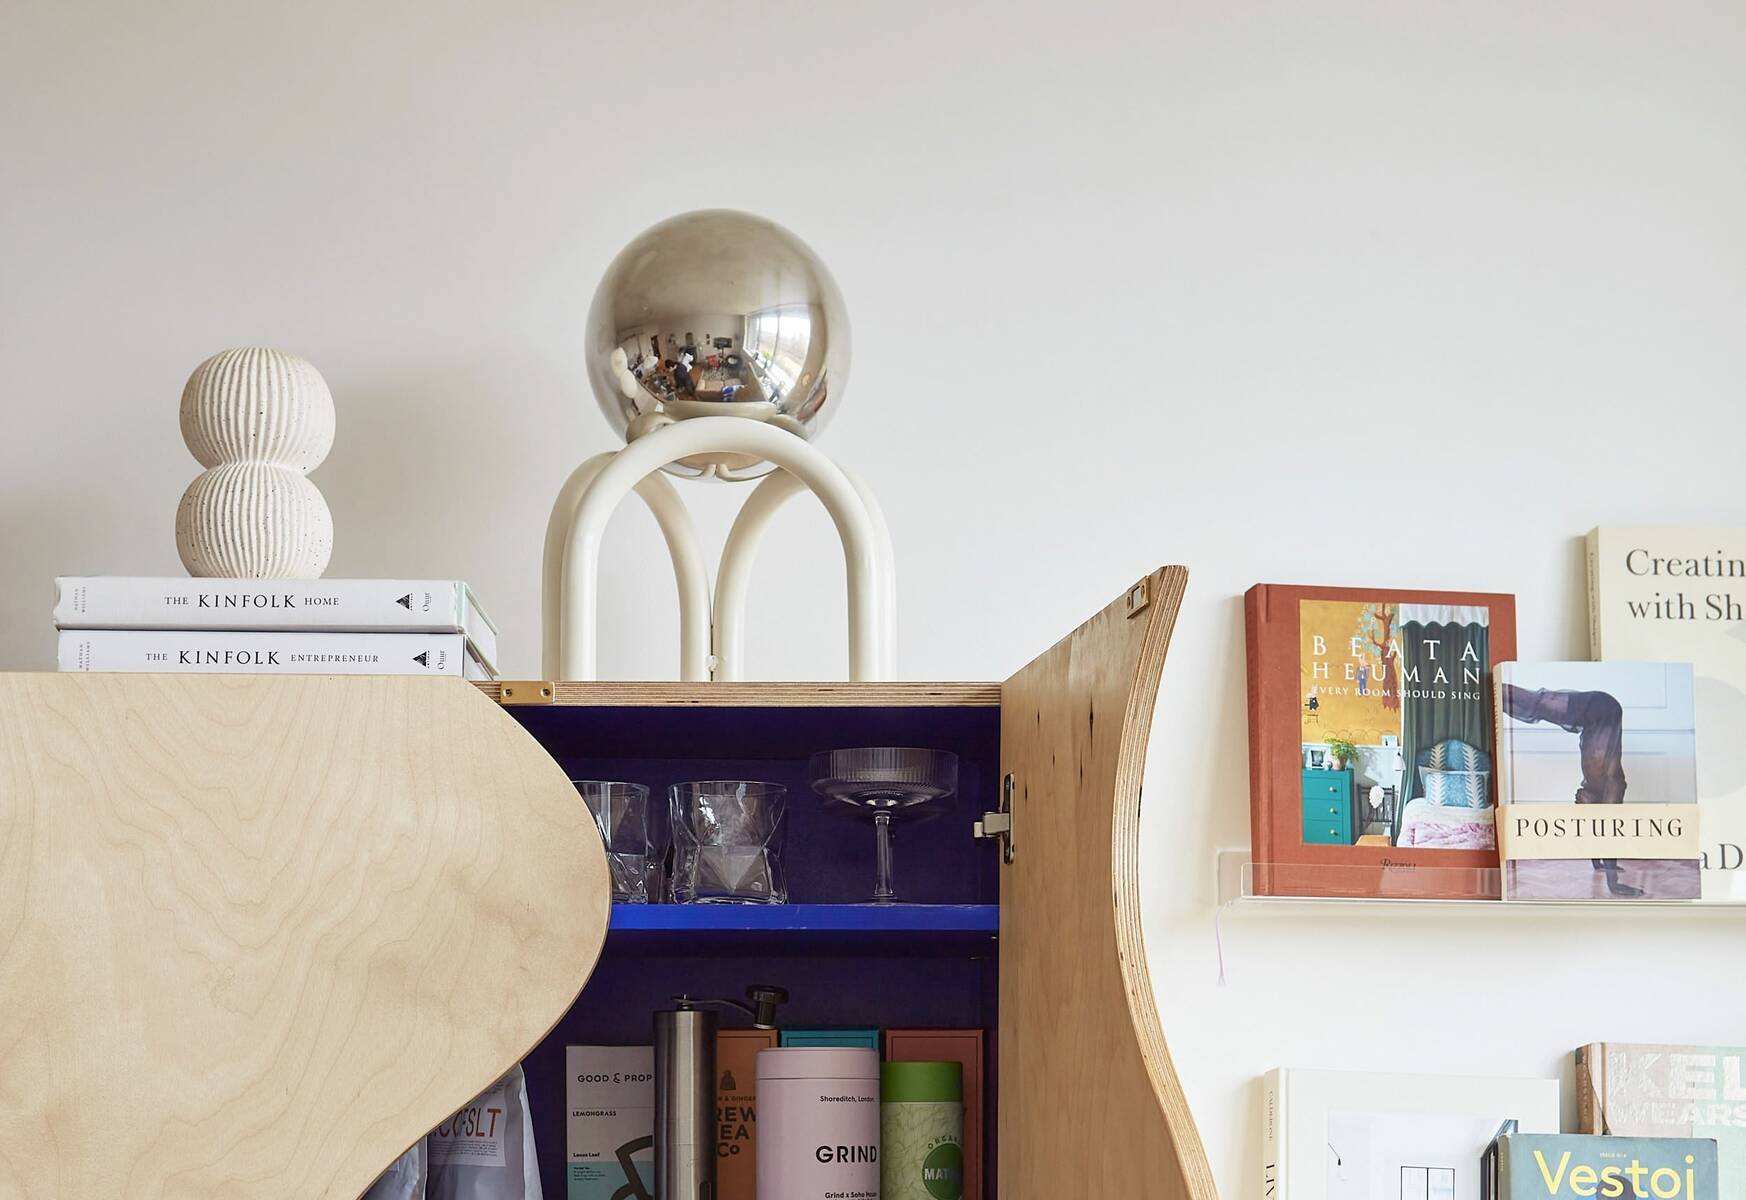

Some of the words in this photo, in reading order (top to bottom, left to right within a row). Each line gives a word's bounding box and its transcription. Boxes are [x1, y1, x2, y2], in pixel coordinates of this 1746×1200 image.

[164, 596, 189, 606] THE
[198, 594, 296, 609] KINFOLK
[304, 597, 340, 606] HOME
[1627, 592, 1696, 620] with
[1705, 593, 1743, 621] Sh
[1313, 635, 1480, 662] BEATA
[145, 652, 169, 661] THE
[179, 650, 281, 666] KINFOLK
[290, 653, 379, 663] ENTREPRENEUR
[1312, 662, 1480, 685] HEUMAN
[1355, 688, 1391, 698] ROOM
[1397, 689, 1446, 699] SHOULD
[1451, 690, 1481, 700] SING
[1515, 818, 1683, 838] POSTURING
[577, 1074, 610, 1083] GOOD
[820, 1095, 858, 1103] Shoreditch,
[718, 1142, 740, 1158] Co
[815, 1145, 878, 1164] GRIND
[824, 1191, 844, 1199] Grind
